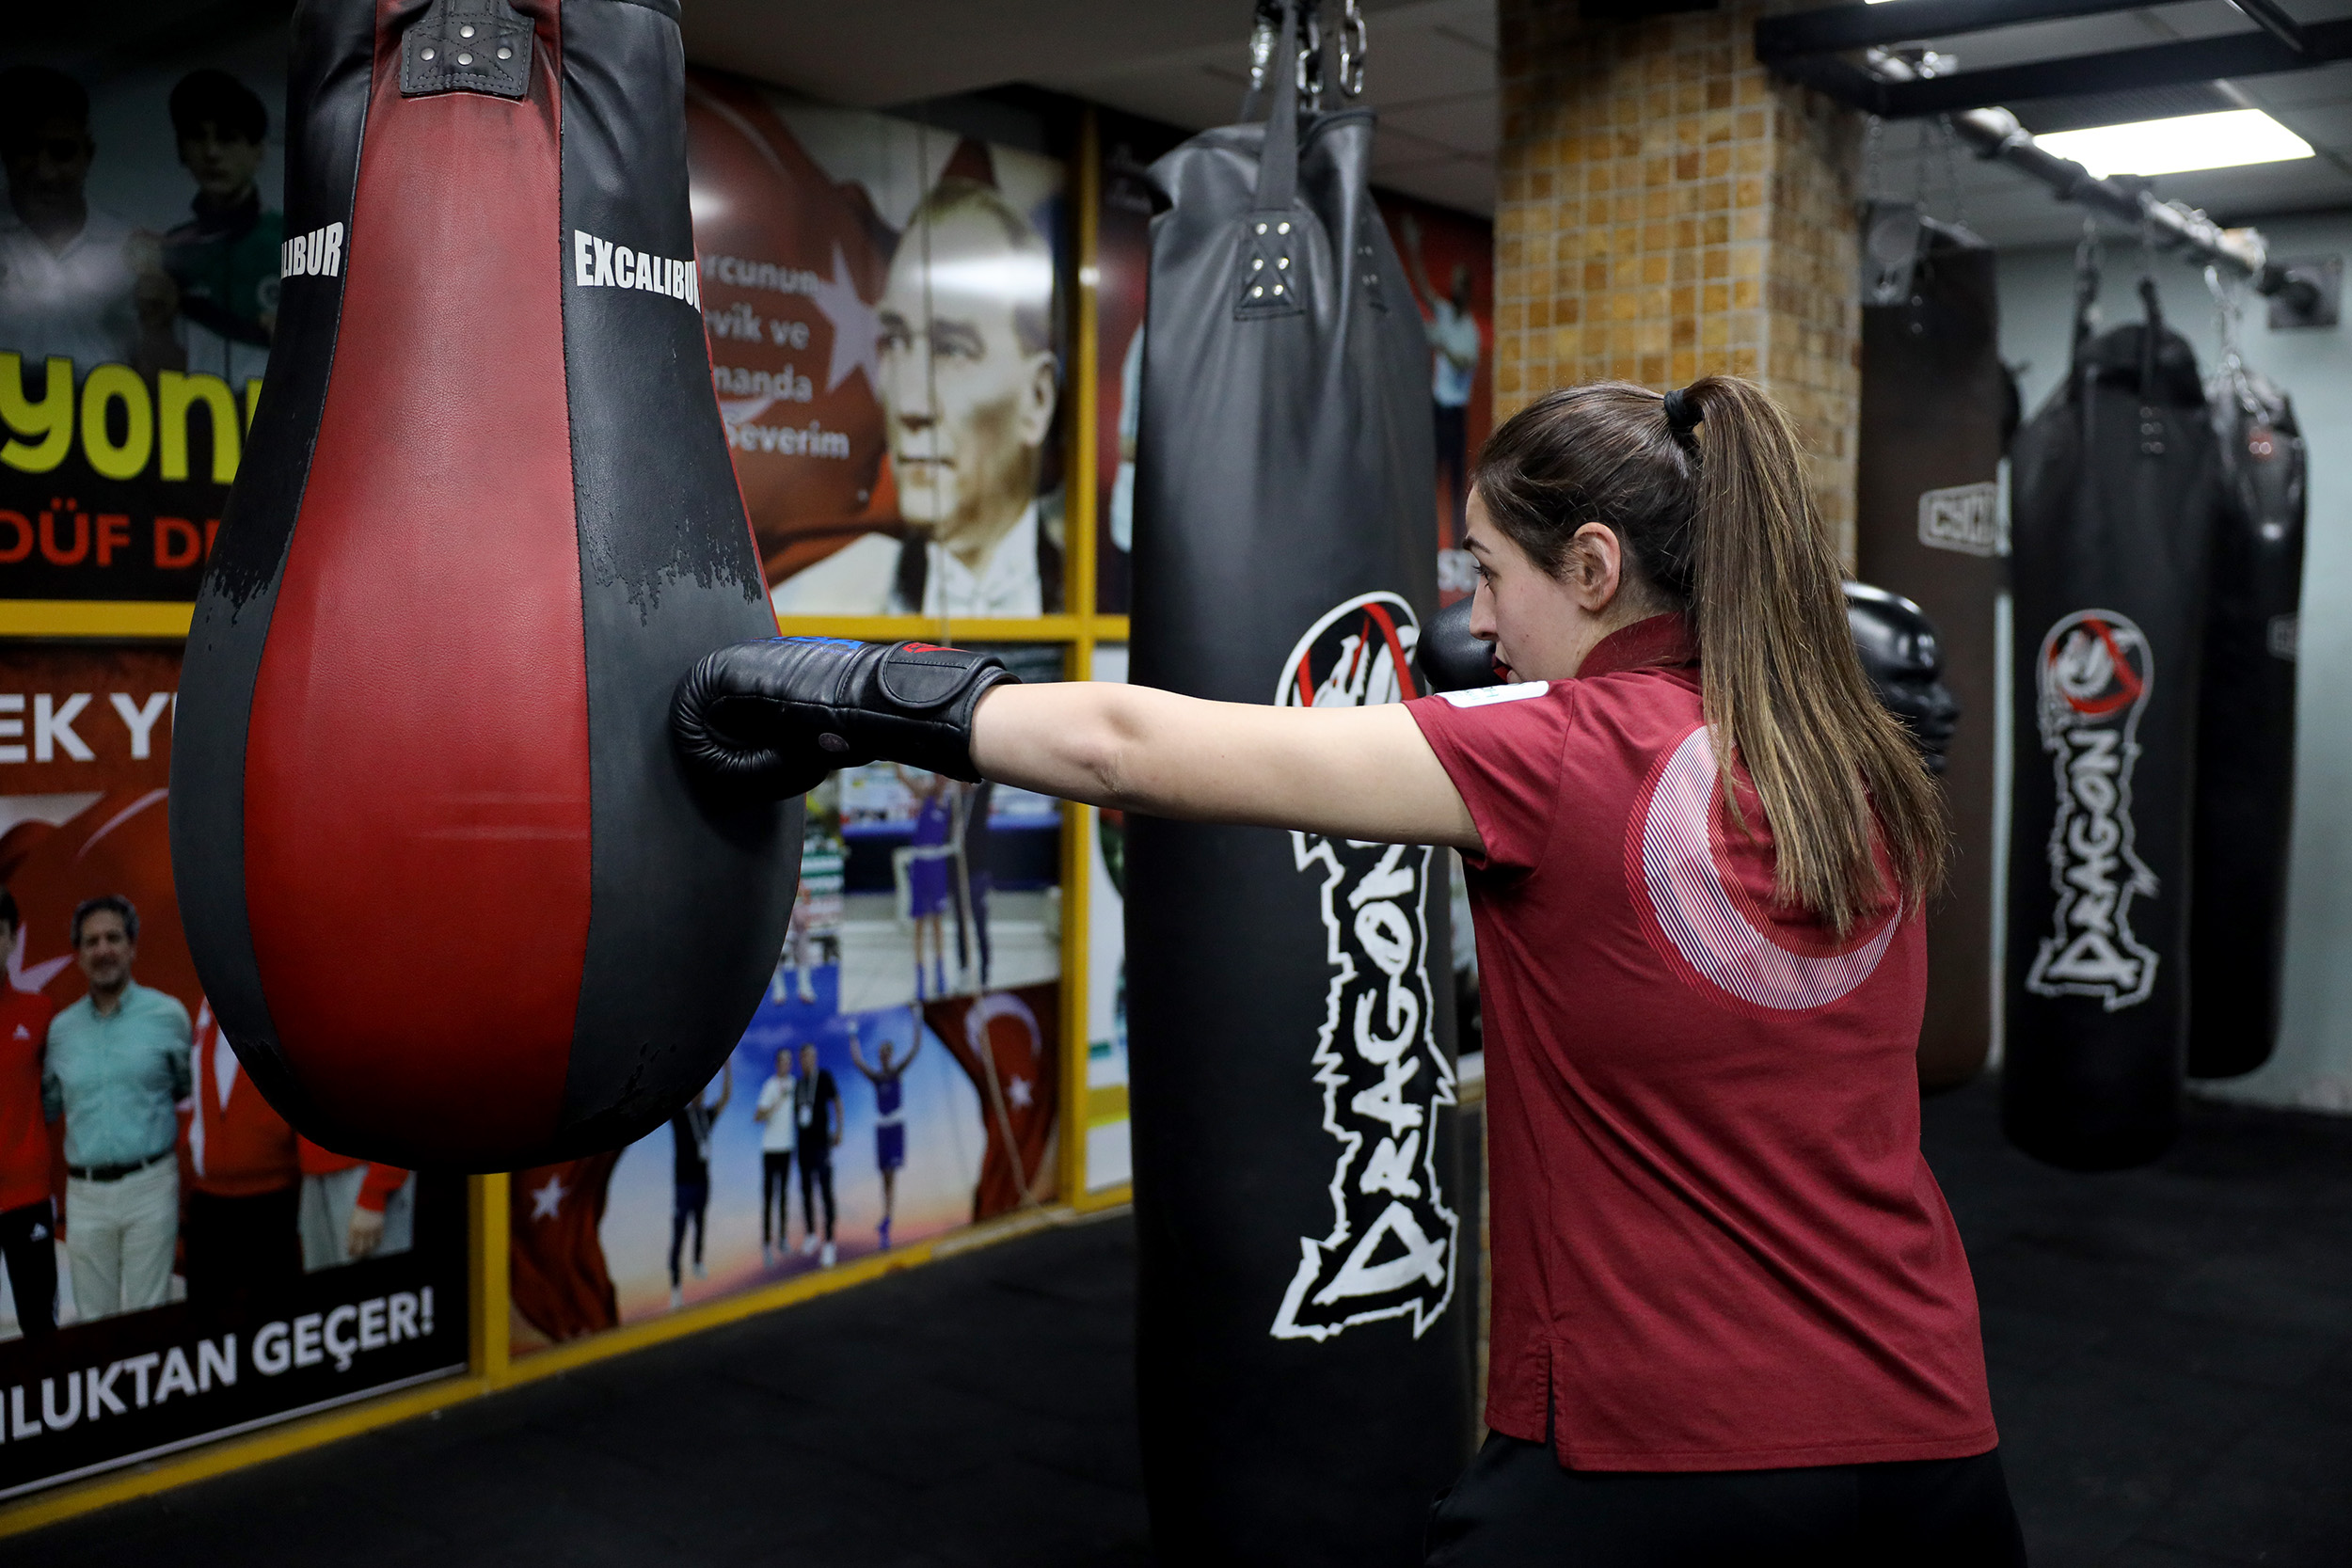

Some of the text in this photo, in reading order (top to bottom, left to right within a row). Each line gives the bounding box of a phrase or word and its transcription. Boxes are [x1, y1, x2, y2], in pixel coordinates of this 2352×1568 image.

[281, 221, 344, 279] LIBUR
[0, 351, 262, 485] yon
[108, 691, 179, 761] Y
[2046, 728, 2143, 990] DRAGON
[0, 1285, 436, 1445] LUKTAN GEÇER!
